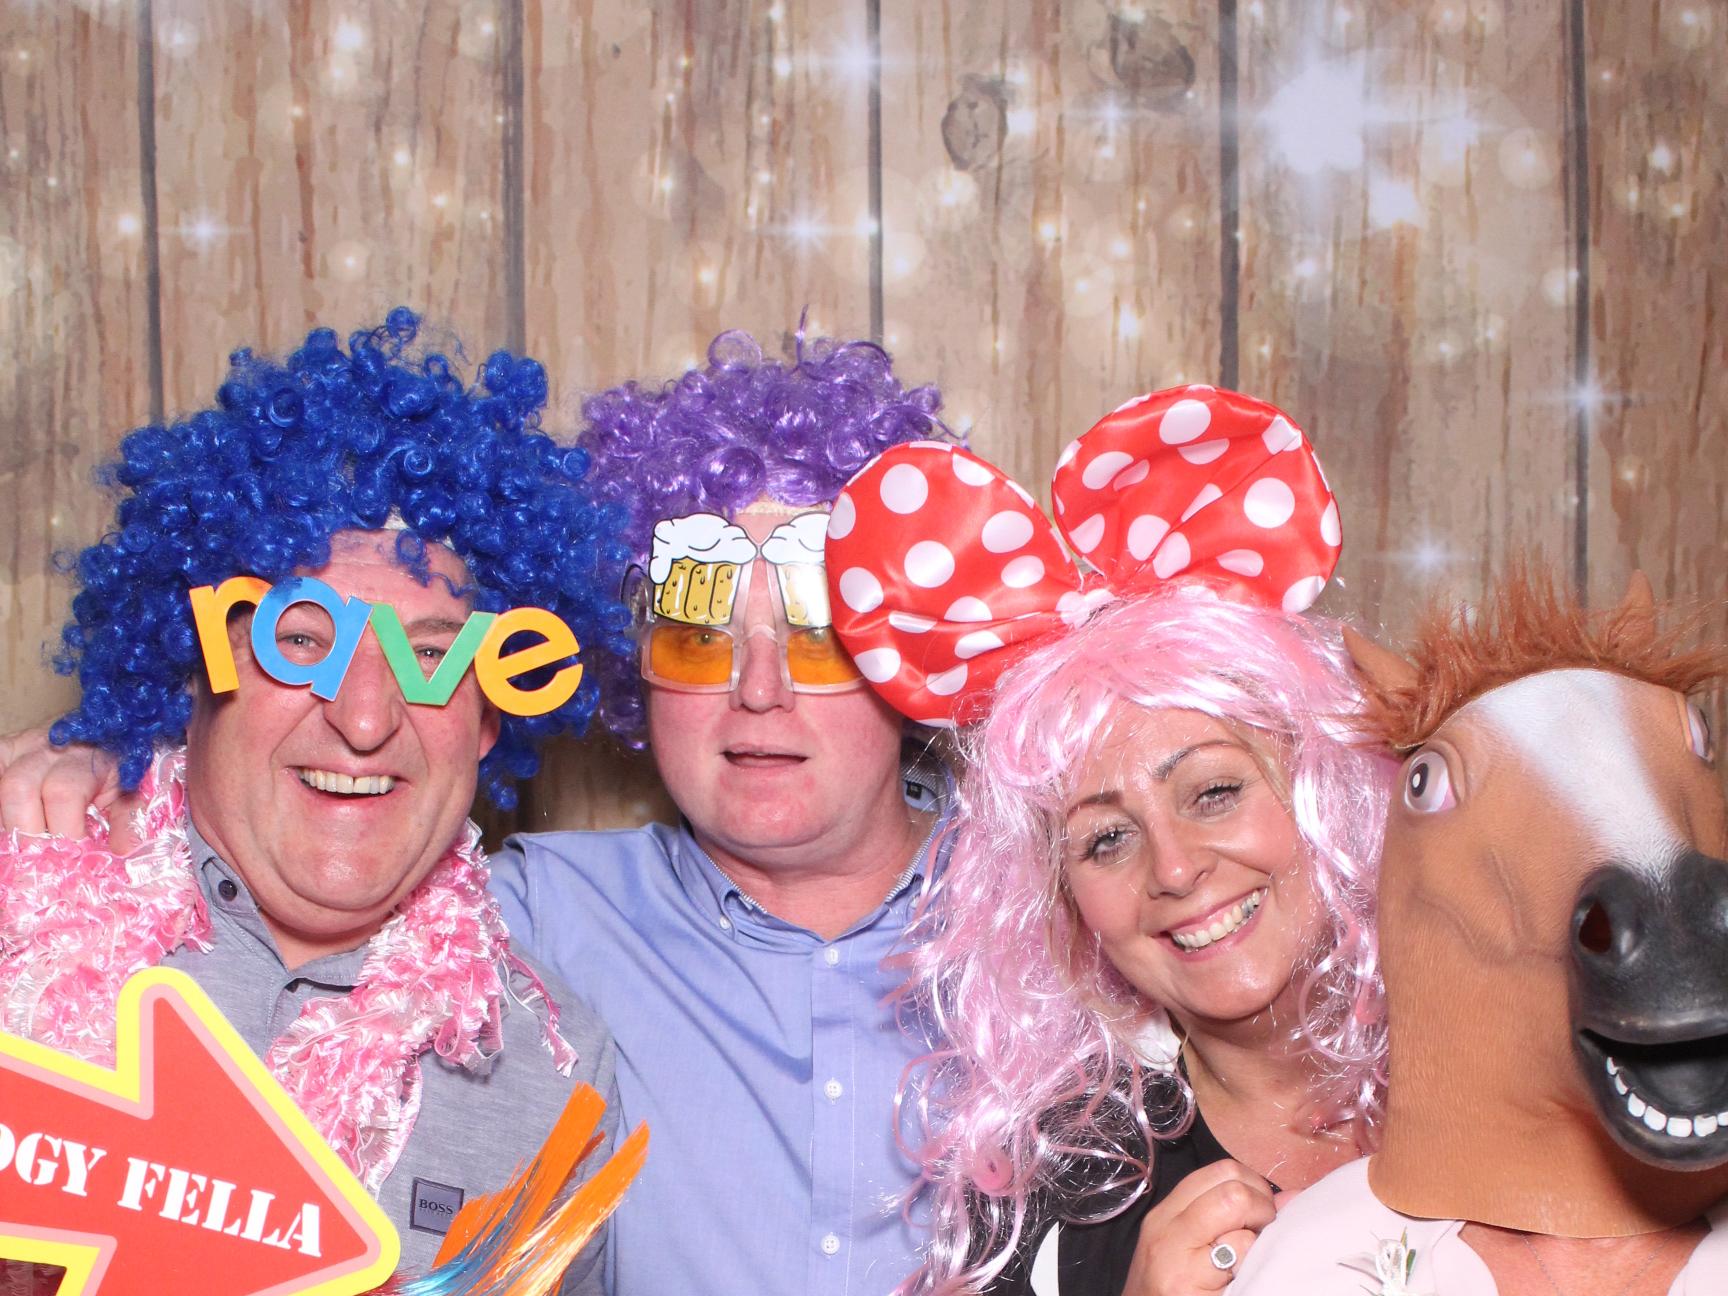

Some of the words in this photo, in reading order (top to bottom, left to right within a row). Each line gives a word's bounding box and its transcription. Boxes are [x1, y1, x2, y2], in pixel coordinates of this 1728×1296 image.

[189, 575, 584, 716] rave
[118, 1157, 322, 1257] FELLA
[419, 1199, 454, 1215] BOSS
